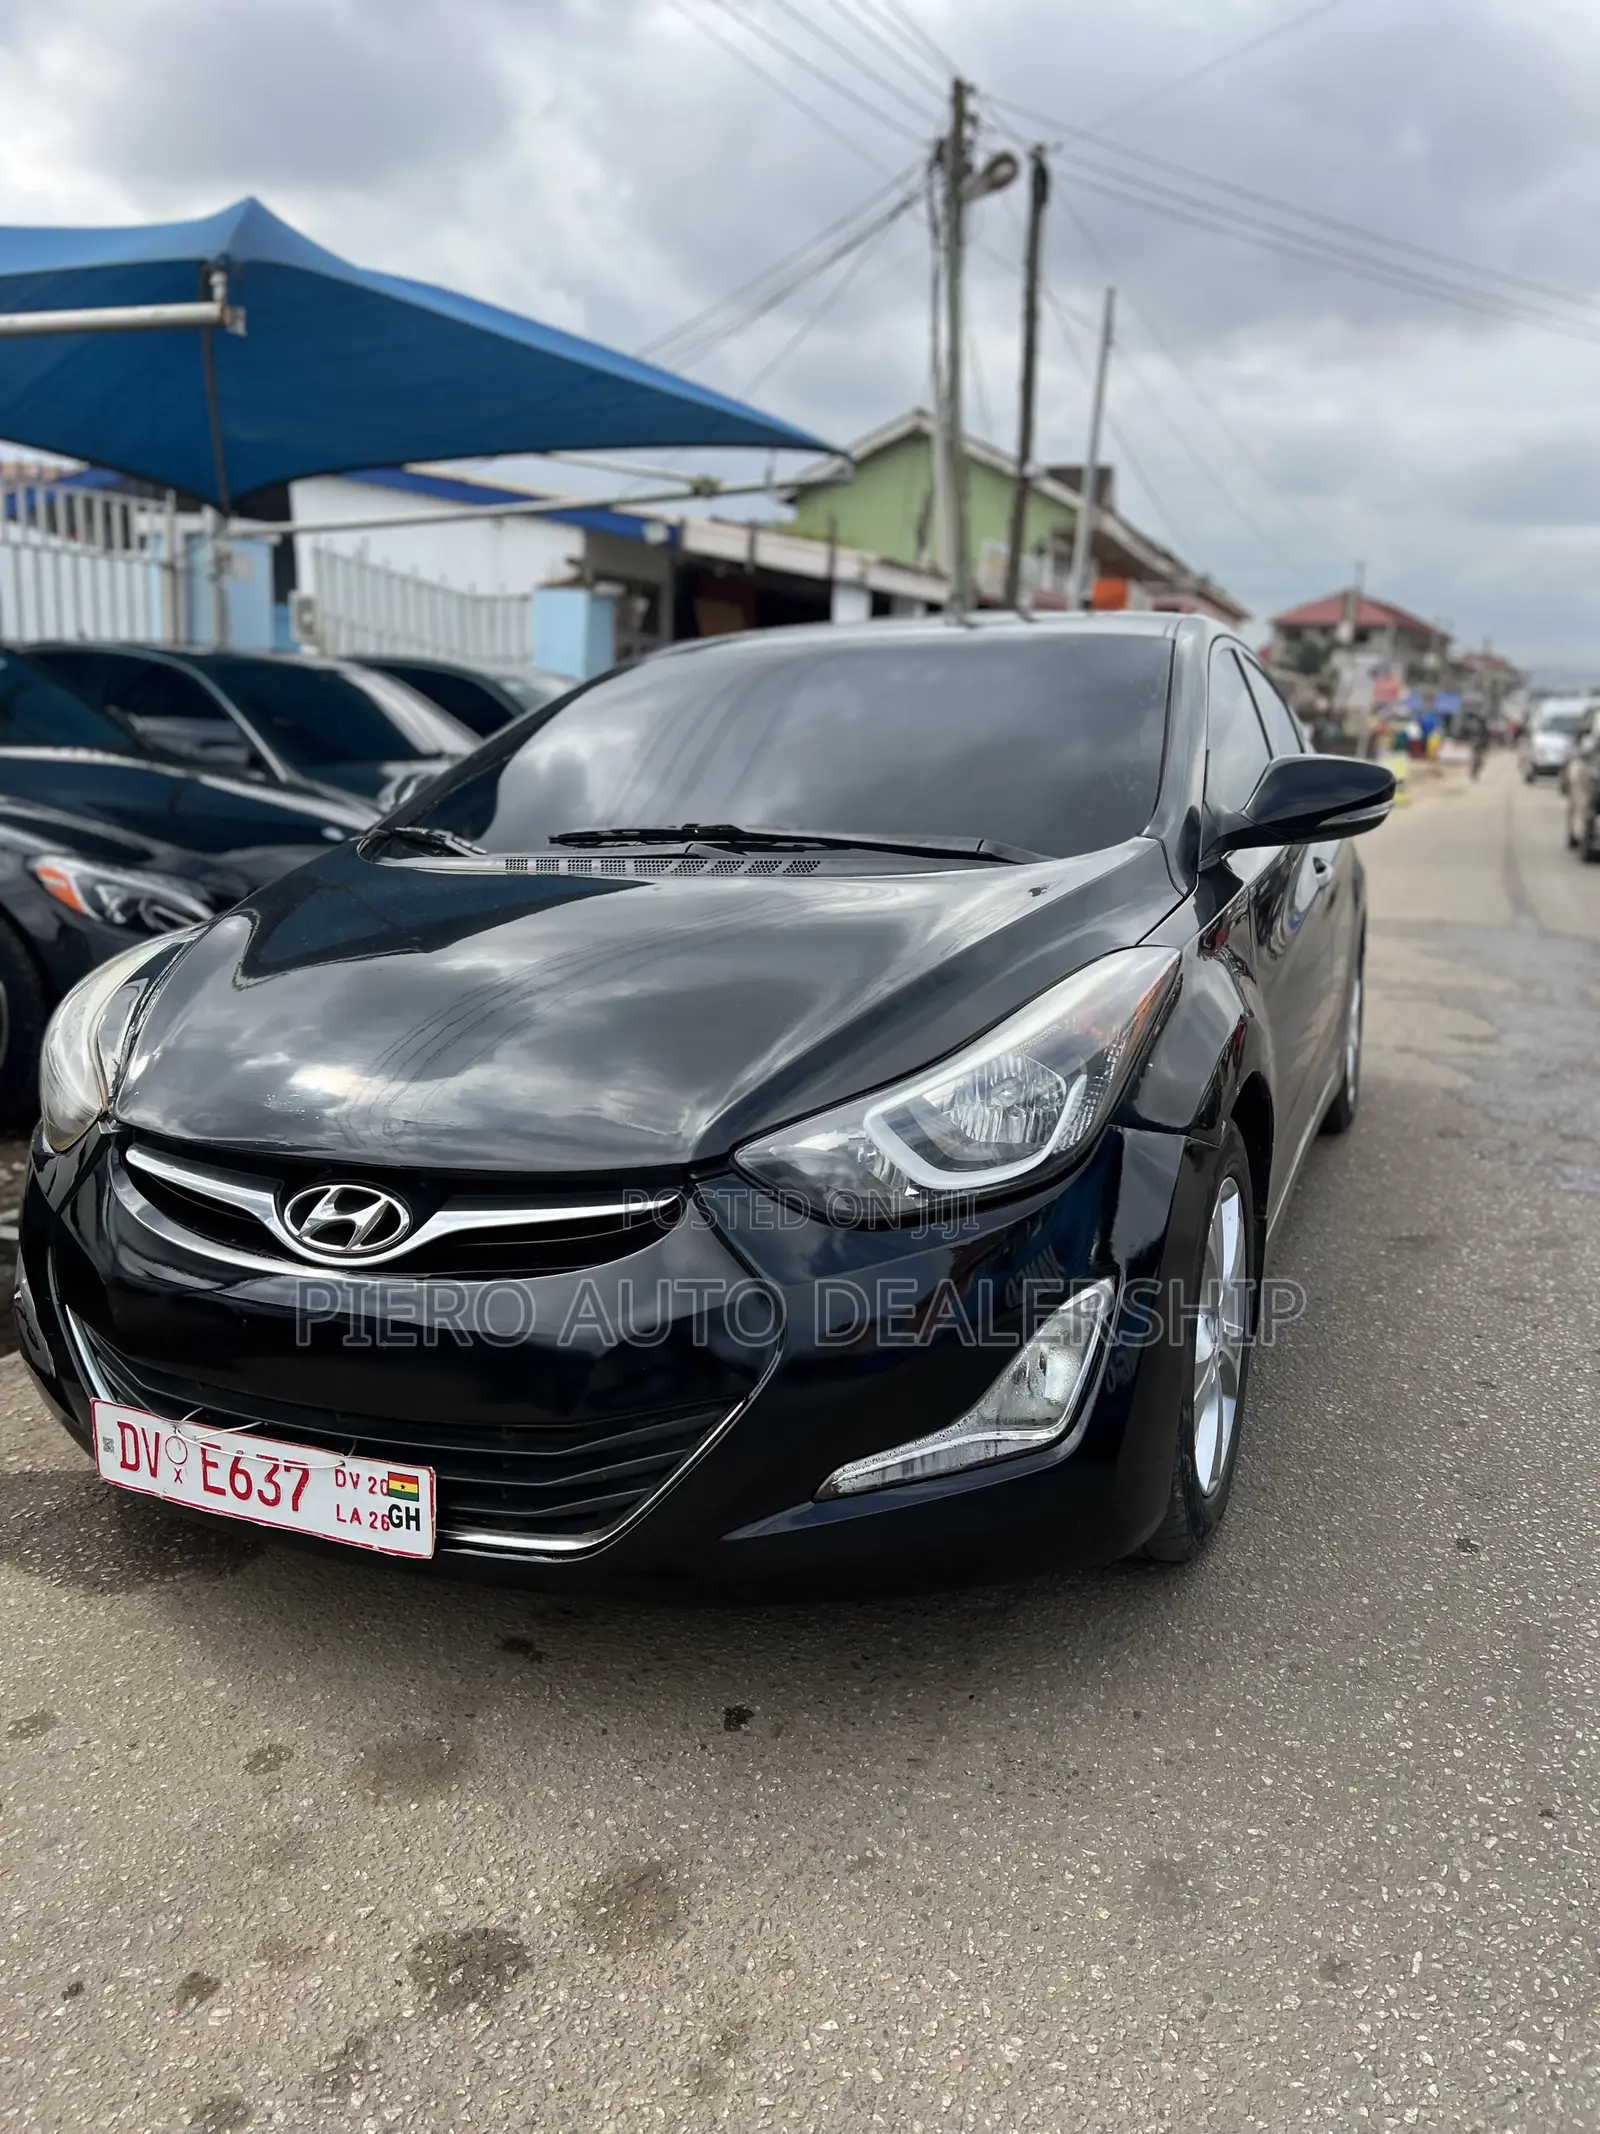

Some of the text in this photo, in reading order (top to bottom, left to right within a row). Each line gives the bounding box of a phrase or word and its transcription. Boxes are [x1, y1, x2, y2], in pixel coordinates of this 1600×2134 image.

[116, 1420, 161, 1479] DV
[200, 1441, 311, 1512] E637
[334, 1468, 361, 1490] DV
[336, 1503, 391, 1532] LA 26
[388, 1503, 421, 1532] GH
